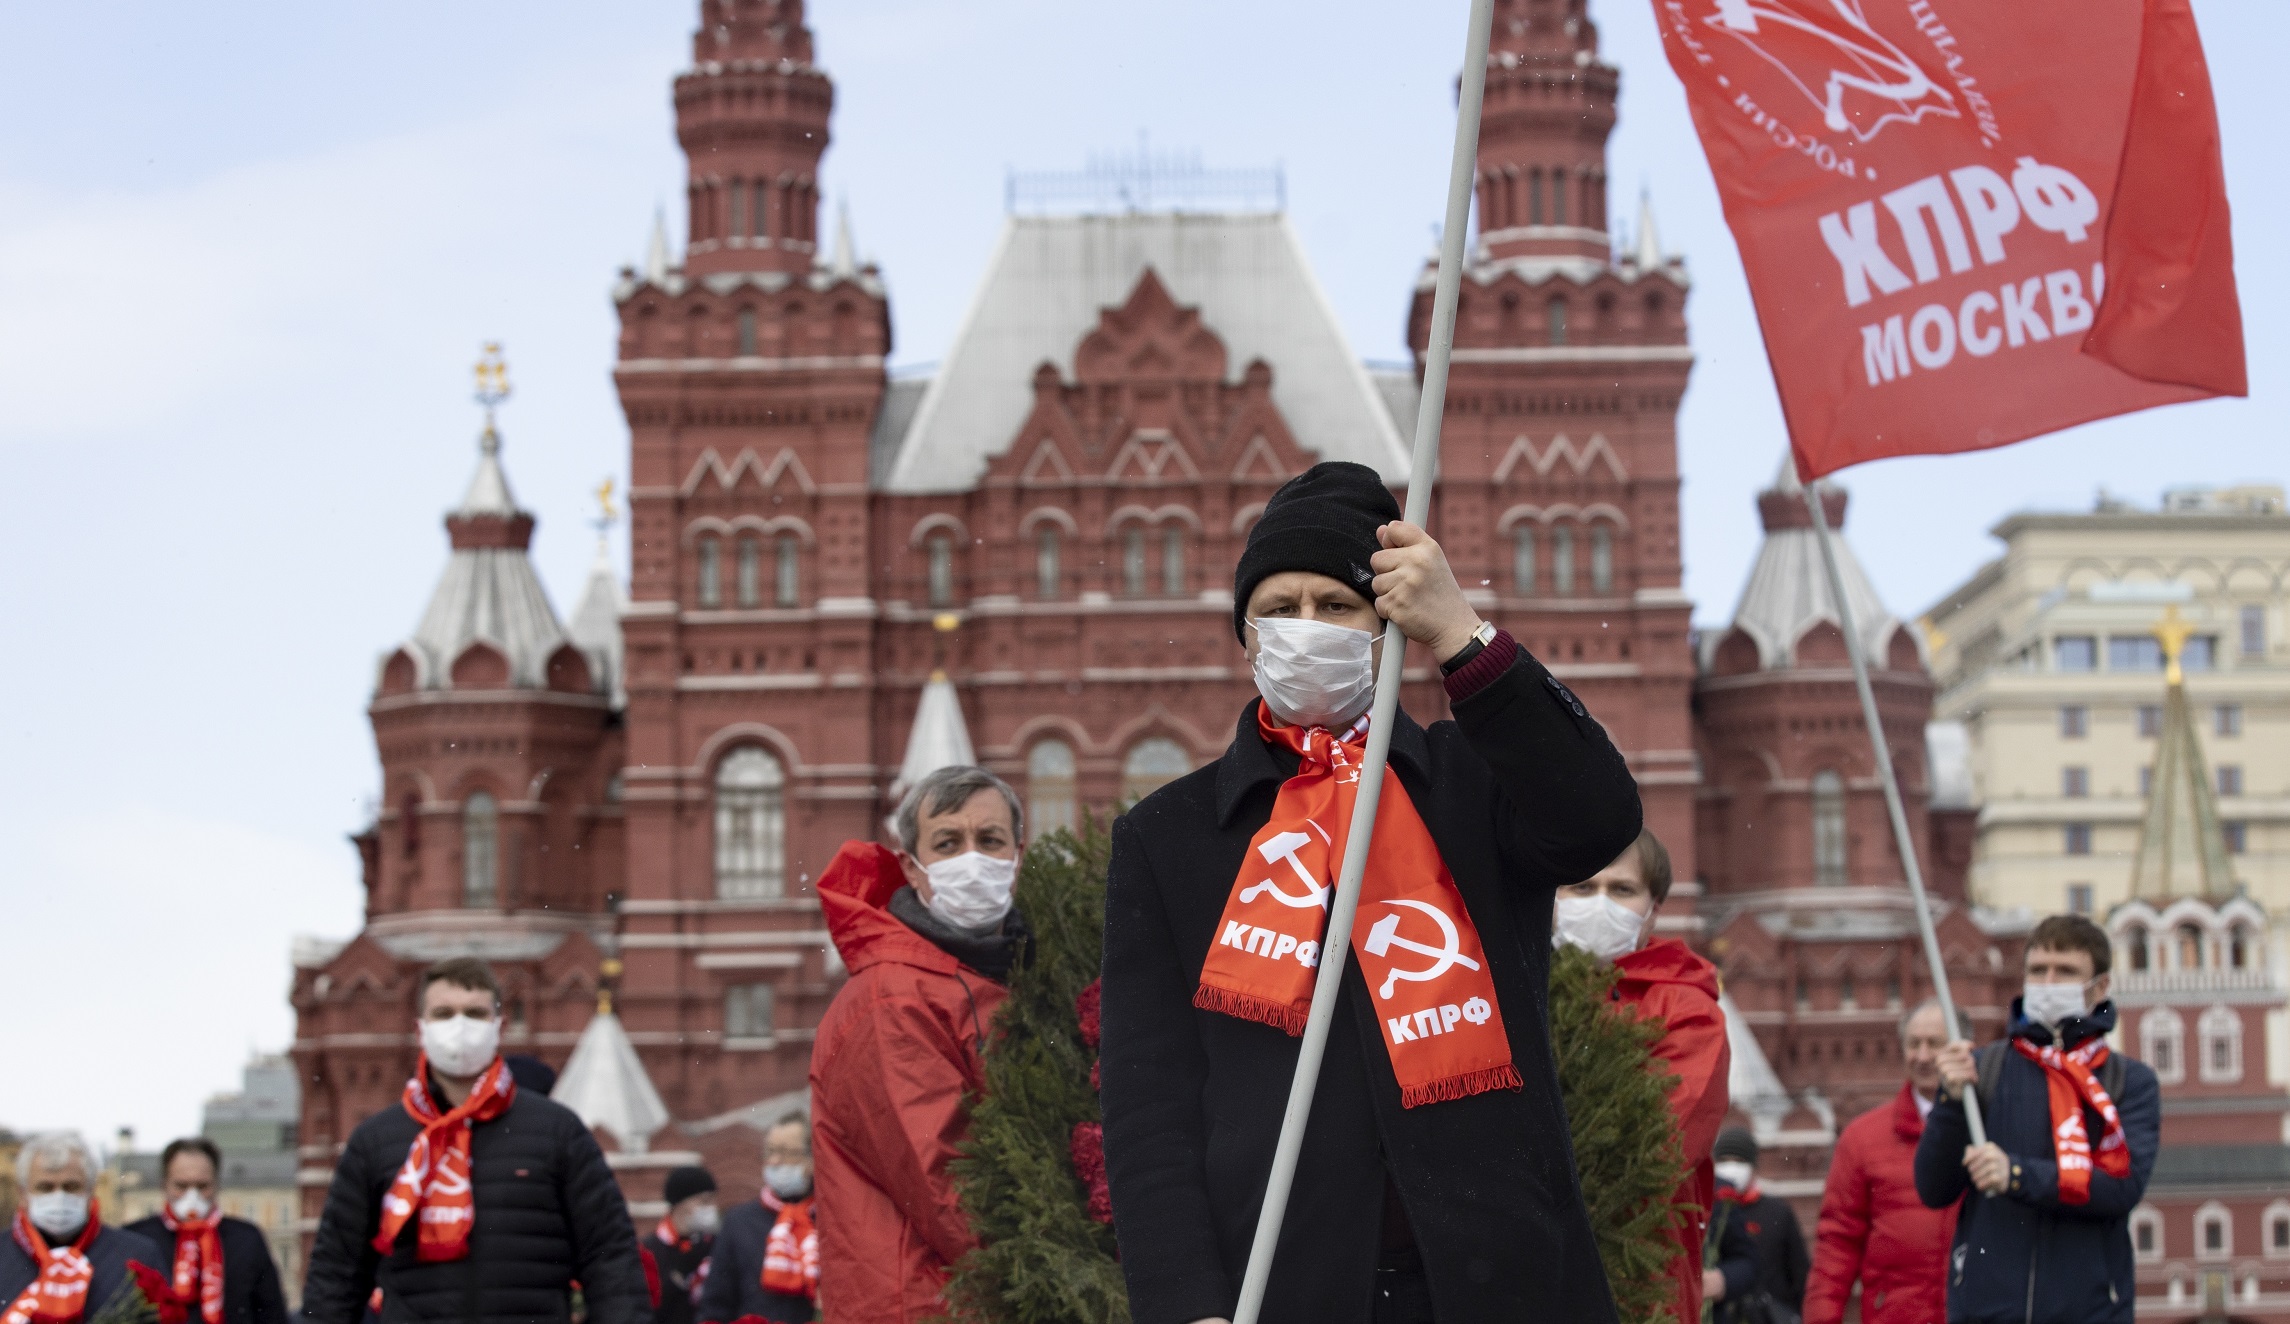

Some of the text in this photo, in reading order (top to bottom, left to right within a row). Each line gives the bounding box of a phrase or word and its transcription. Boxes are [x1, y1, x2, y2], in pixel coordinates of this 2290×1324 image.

[1818, 156, 2099, 307] КПРФ
[1860, 262, 2105, 386] МОСКВ
[1220, 919, 1320, 968] КПРФ
[1387, 996, 1492, 1044] КПРФ
